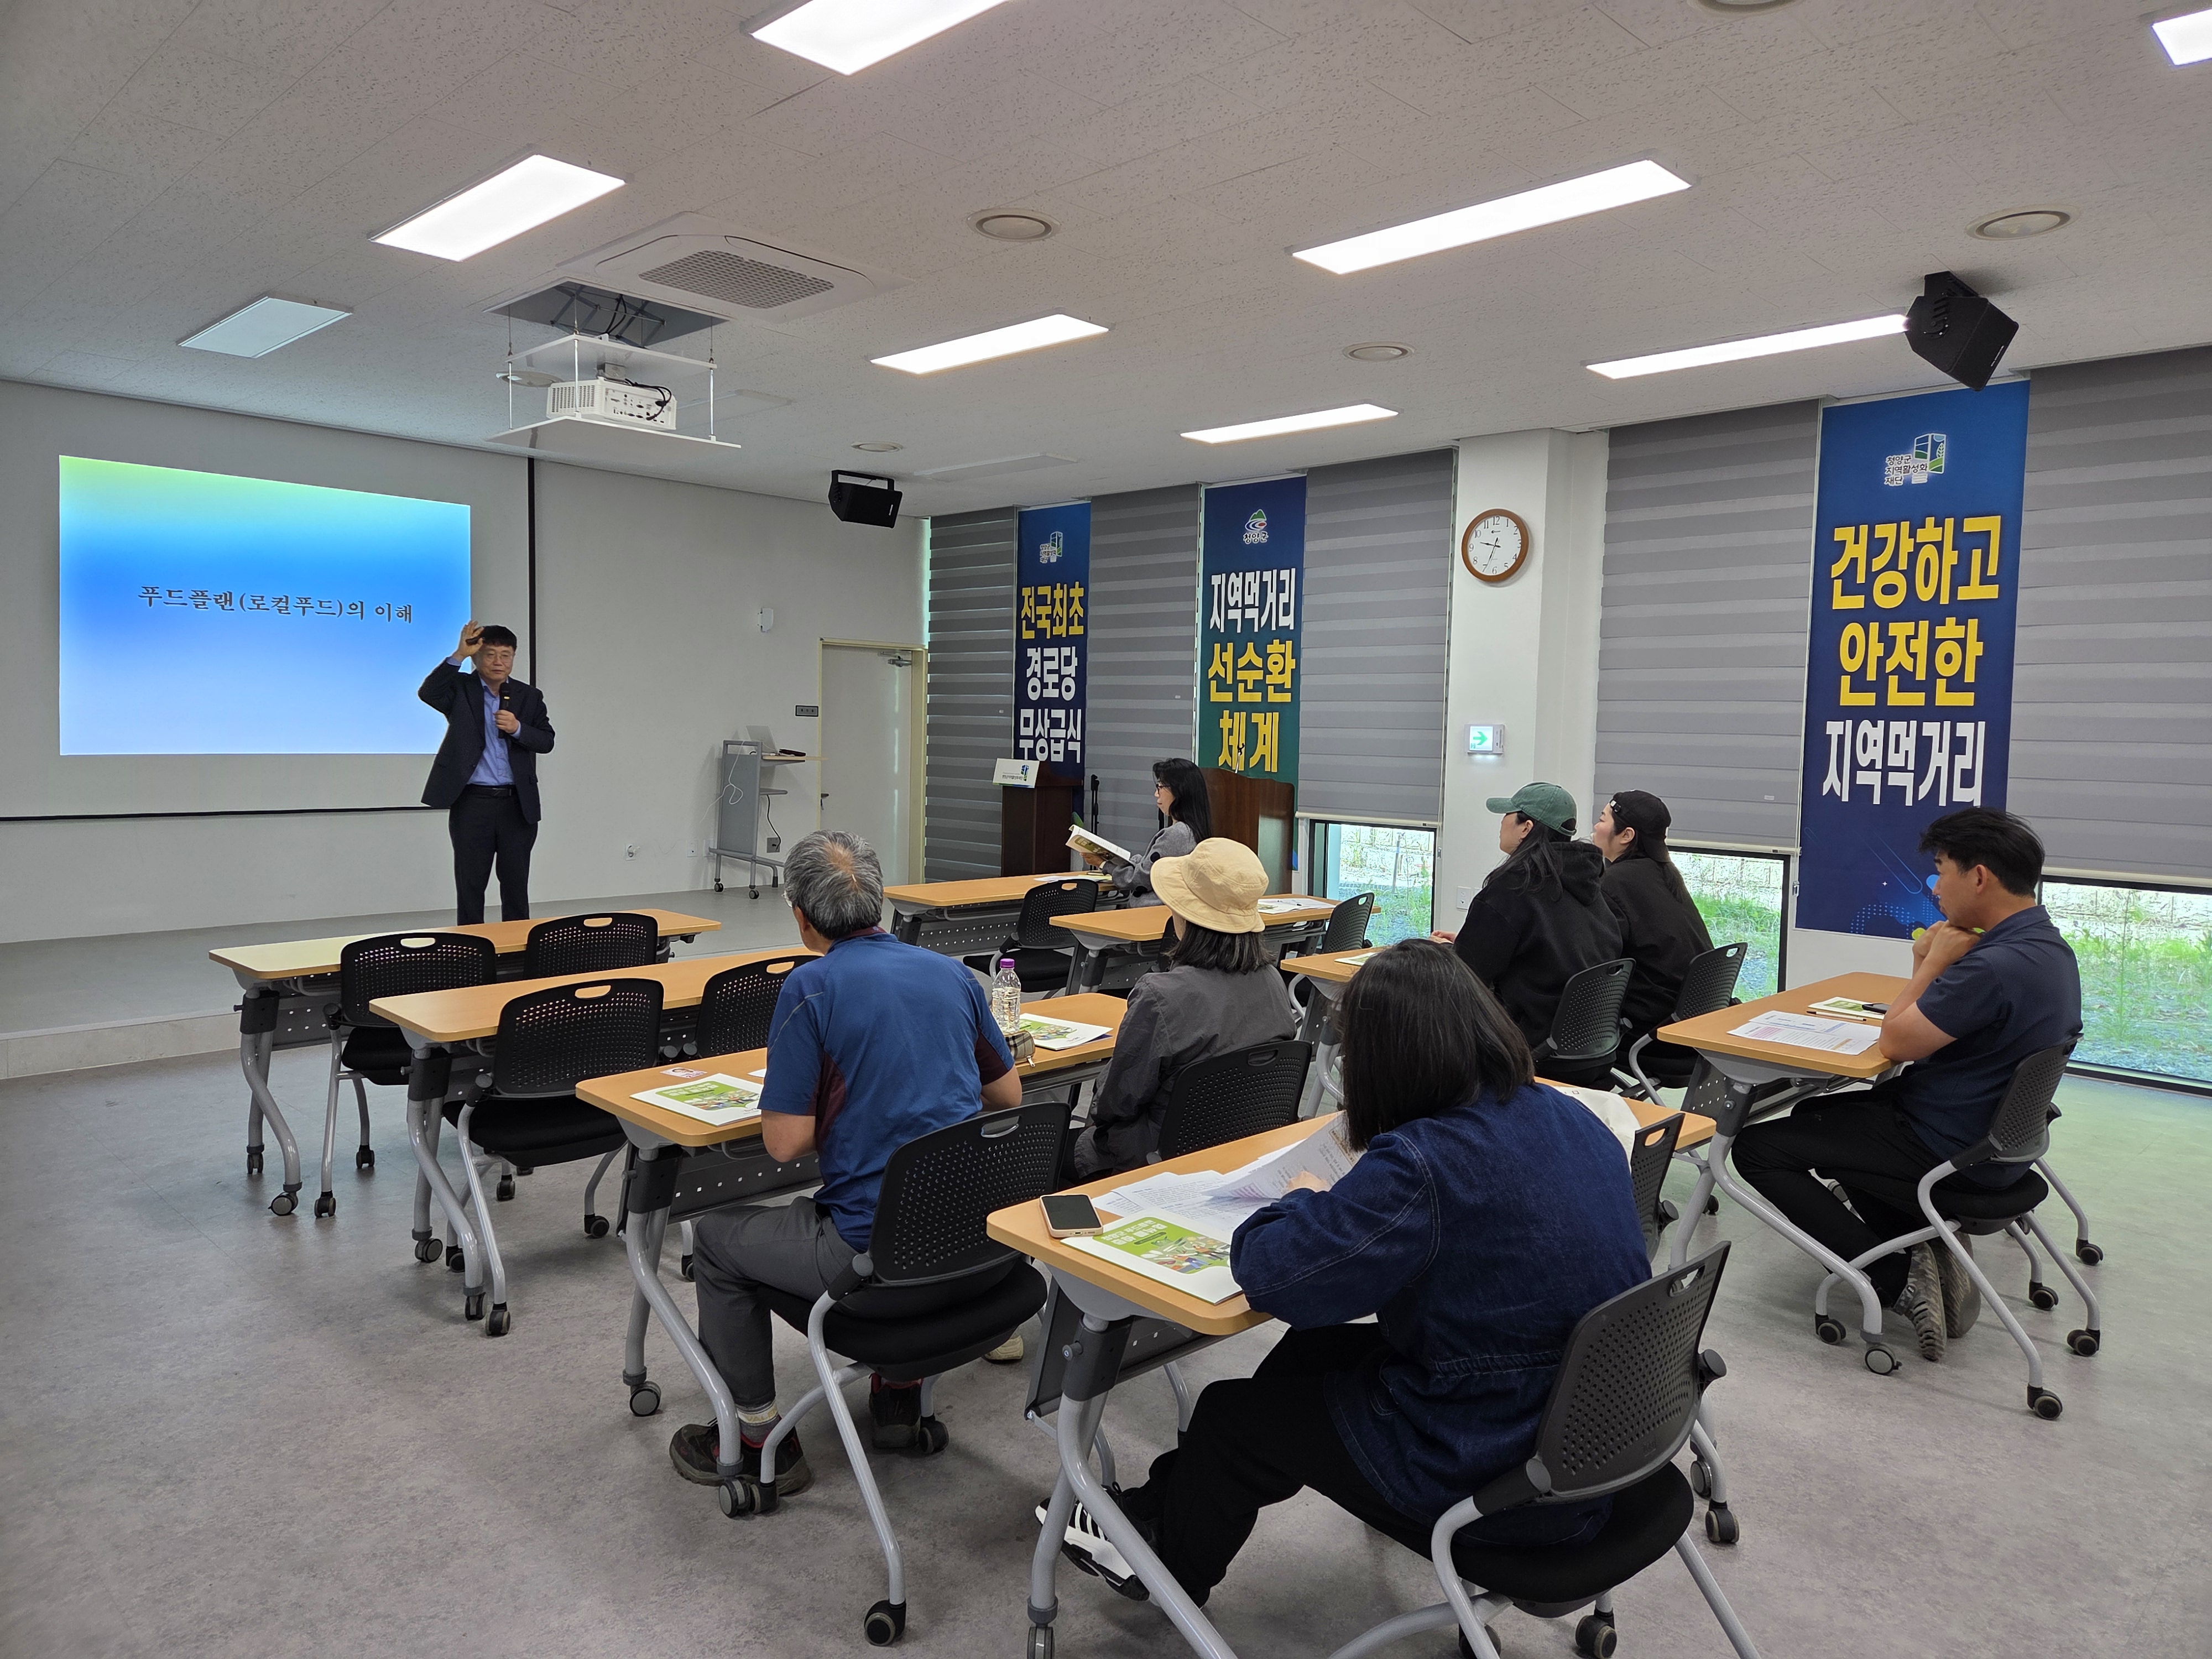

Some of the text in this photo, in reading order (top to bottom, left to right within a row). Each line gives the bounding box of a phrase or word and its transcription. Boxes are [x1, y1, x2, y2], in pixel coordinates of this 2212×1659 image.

[1886, 455, 1912, 466] 청양군
[1885, 463, 1928, 475] 지역활성화
[1885, 476, 1903, 485] 재단
[1483, 520, 1489, 529] 11
[1493, 516, 1500, 525] 12
[1506, 518, 1509, 527] 1
[1474, 529, 1481, 538] 10
[1513, 526, 1519, 535] 2
[1244, 531, 1268, 544] 청양군
[1469, 544, 1474, 552] 9
[1517, 539, 1522, 548] 3
[1473, 556, 1478, 565] 8
[1830, 515, 2002, 610] 건강하고
[1482, 564, 1488, 572] 7
[1492, 566, 1497, 575] 6
[137, 585, 412, 624] 푸드플랜(로컬푸드)의 이해
[1209, 568, 1296, 633] 지역먹거리
[1021, 581, 1084, 639] 전국최초
[1839, 617, 1984, 707] 안전한
[1026, 646, 1078, 701] 경로당
[1208, 639, 1296, 702] 선순환
[1019, 708, 1082, 763] 무상급식
[1218, 710, 1279, 773] 체계
[1822, 719, 1988, 807] 지역먹거리
